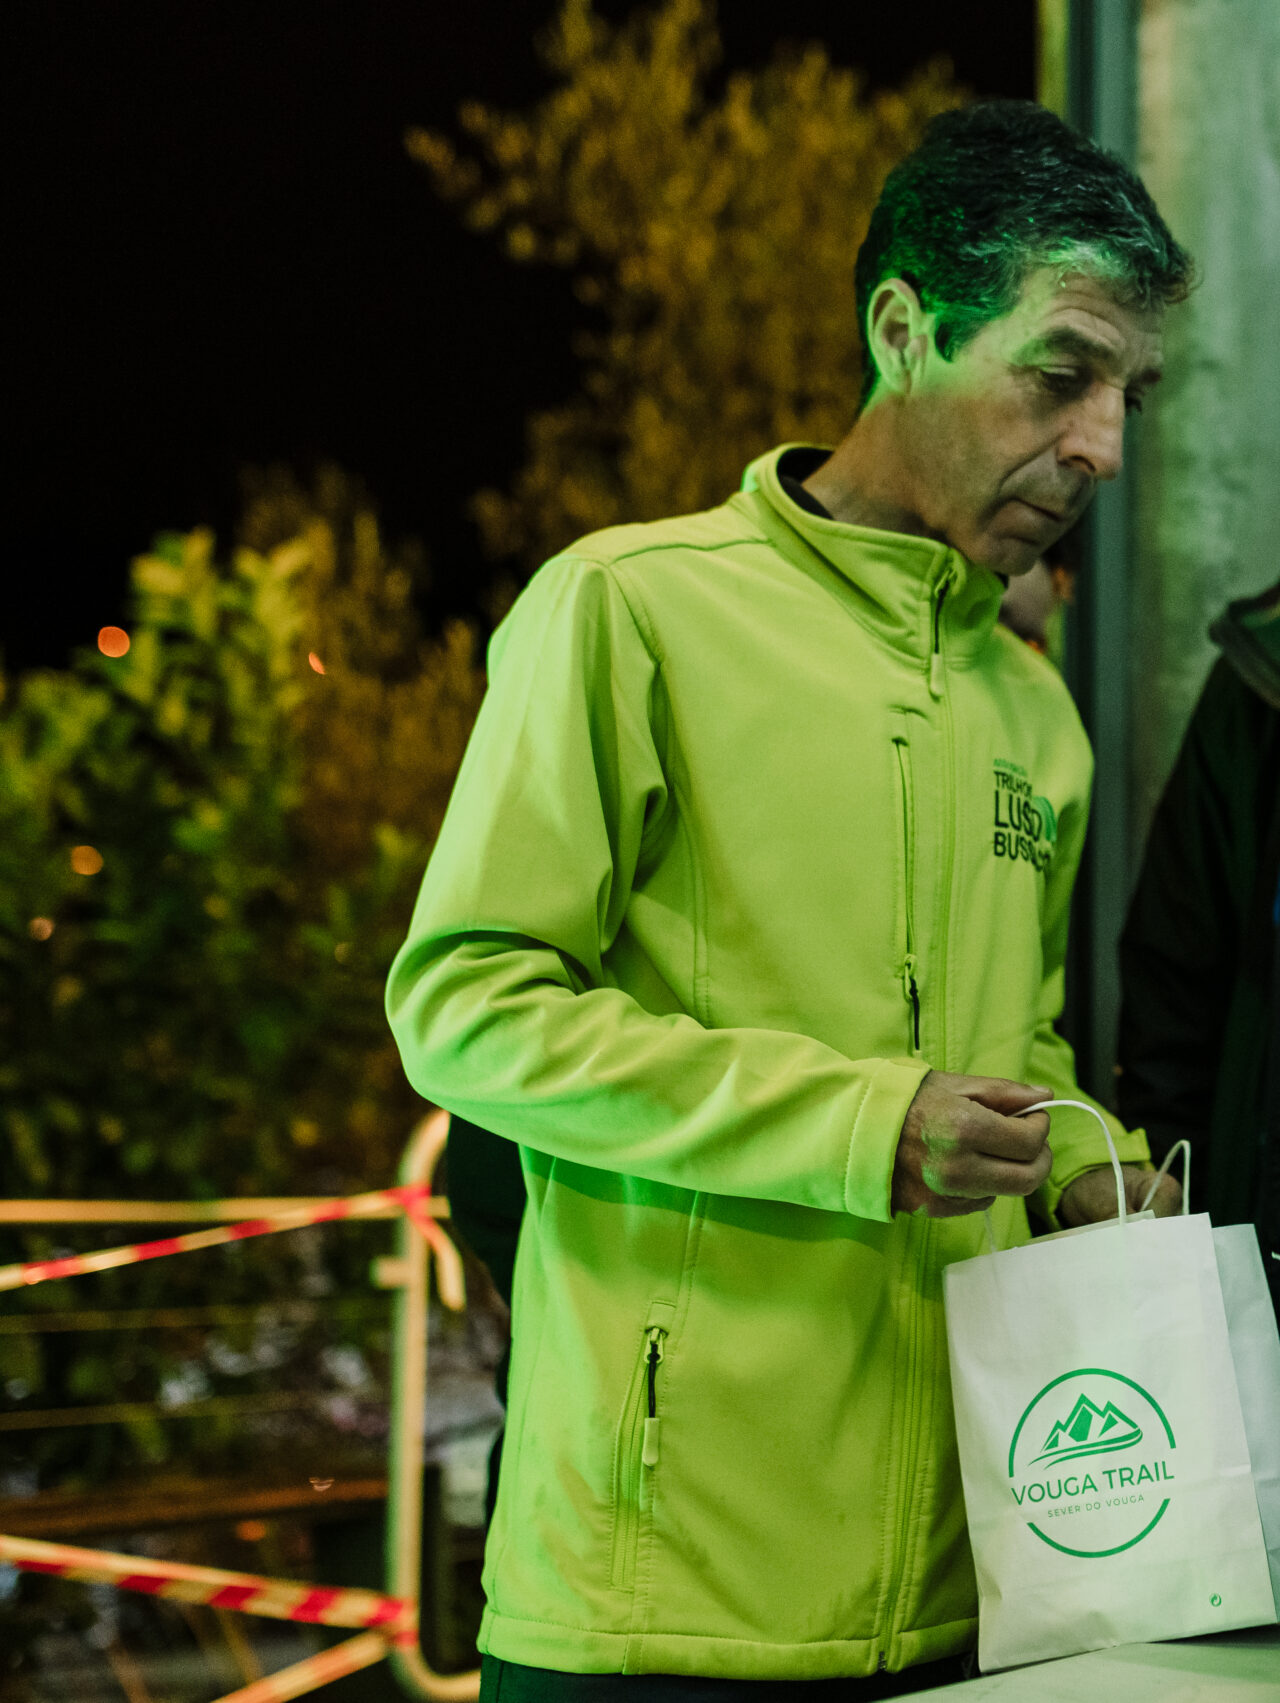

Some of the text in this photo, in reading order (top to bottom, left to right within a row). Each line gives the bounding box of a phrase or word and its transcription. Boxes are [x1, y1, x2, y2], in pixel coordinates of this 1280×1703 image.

[1011, 1460, 1175, 1506] VOUGA TRAIL
[1047, 1494, 1146, 1518] SEVER DO VOUGA
